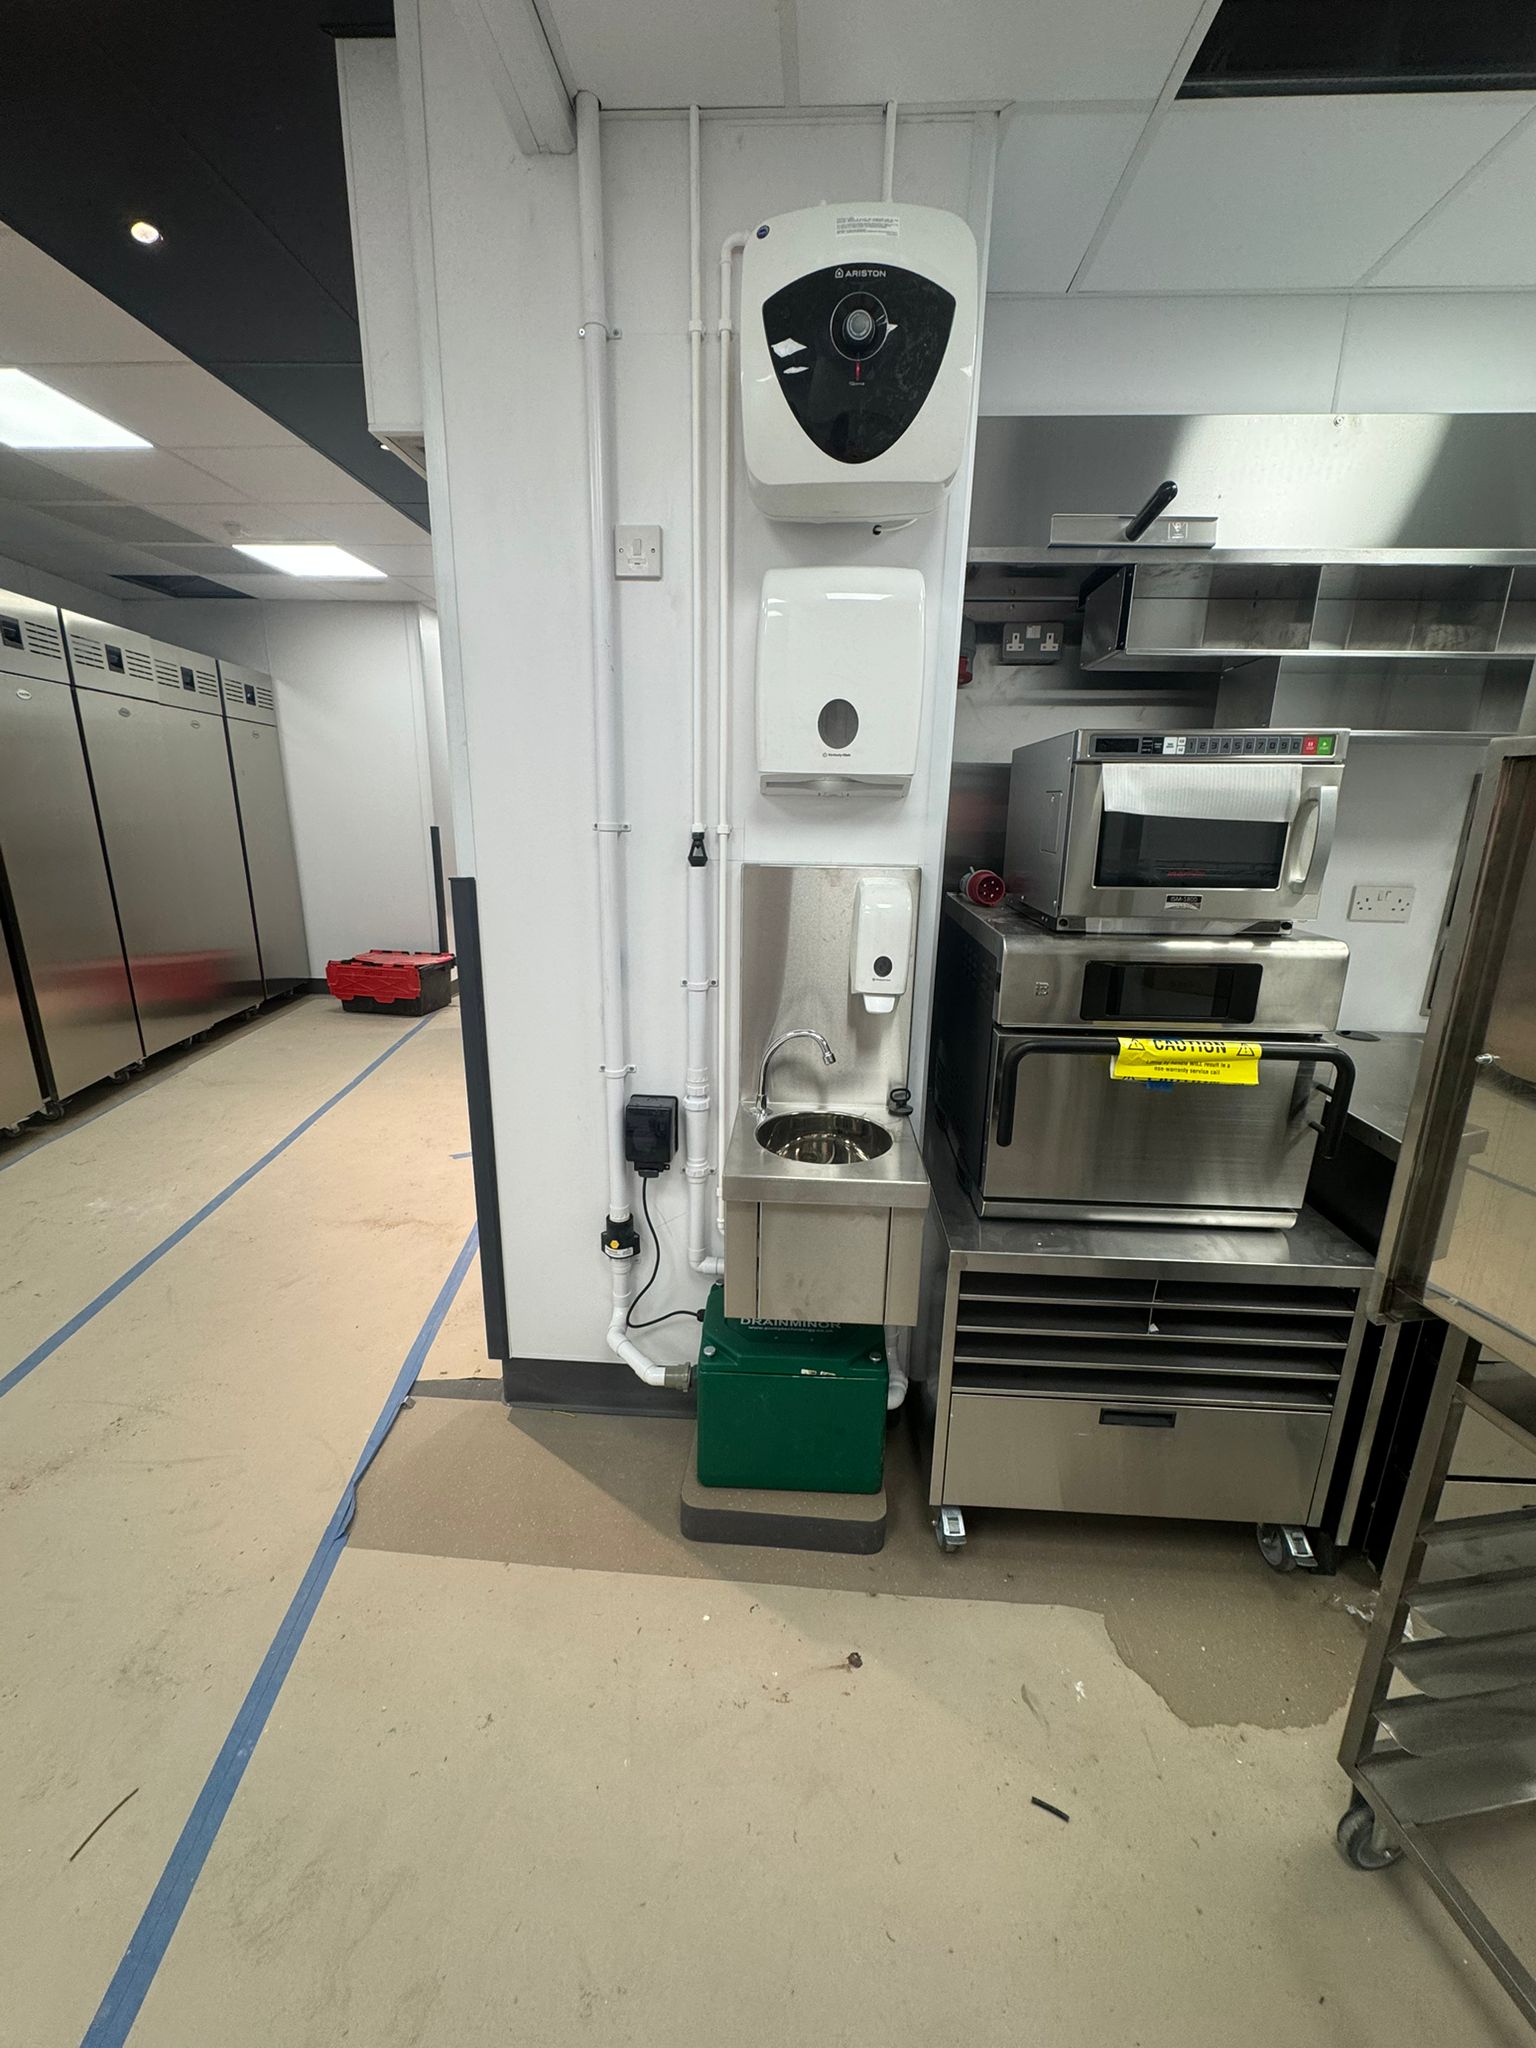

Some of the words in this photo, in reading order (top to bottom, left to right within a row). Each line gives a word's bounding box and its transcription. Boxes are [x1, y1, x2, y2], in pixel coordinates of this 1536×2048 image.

[845, 270, 887, 278] ARISTON
[1153, 1040, 1226, 1053] CAUTION
[740, 1318, 841, 1329] DRAINMINOR
